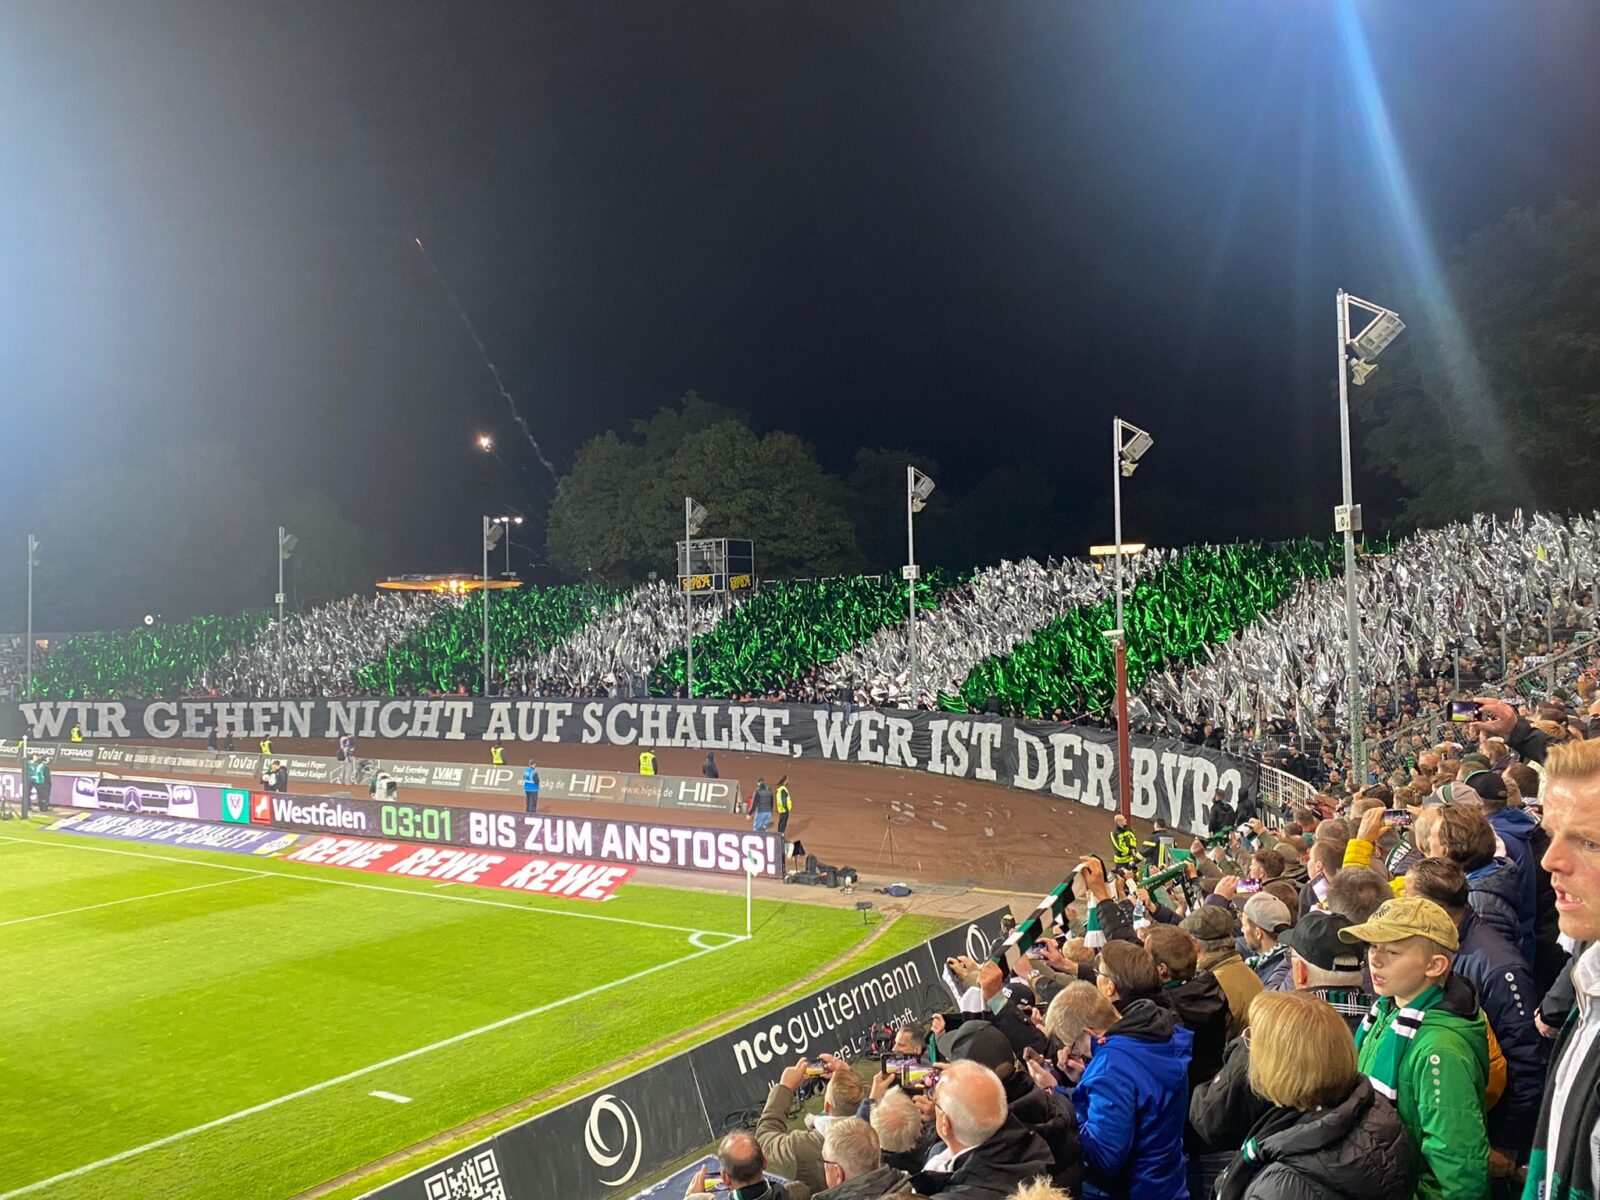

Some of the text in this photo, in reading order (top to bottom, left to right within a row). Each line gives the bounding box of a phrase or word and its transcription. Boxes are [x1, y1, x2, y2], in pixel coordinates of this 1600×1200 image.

[19, 701, 131, 739] WIR
[143, 701, 315, 739] GEHEN
[326, 700, 473, 740] NICHT
[482, 702, 571, 743] AUF
[583, 704, 803, 758] SCHALKE,
[813, 710, 918, 768] WER
[927, 720, 1002, 781] IST
[1014, 728, 1119, 811] DER
[471, 768, 514, 786] HIP
[569, 774, 617, 794] HIP
[679, 781, 729, 802] HIP
[271, 798, 776, 876] Westfalen 03:01 BIS ZUM ANSTOSS!
[287, 837, 399, 868] REWE
[387, 847, 506, 883] REWE
[500, 859, 628, 899] REWE
